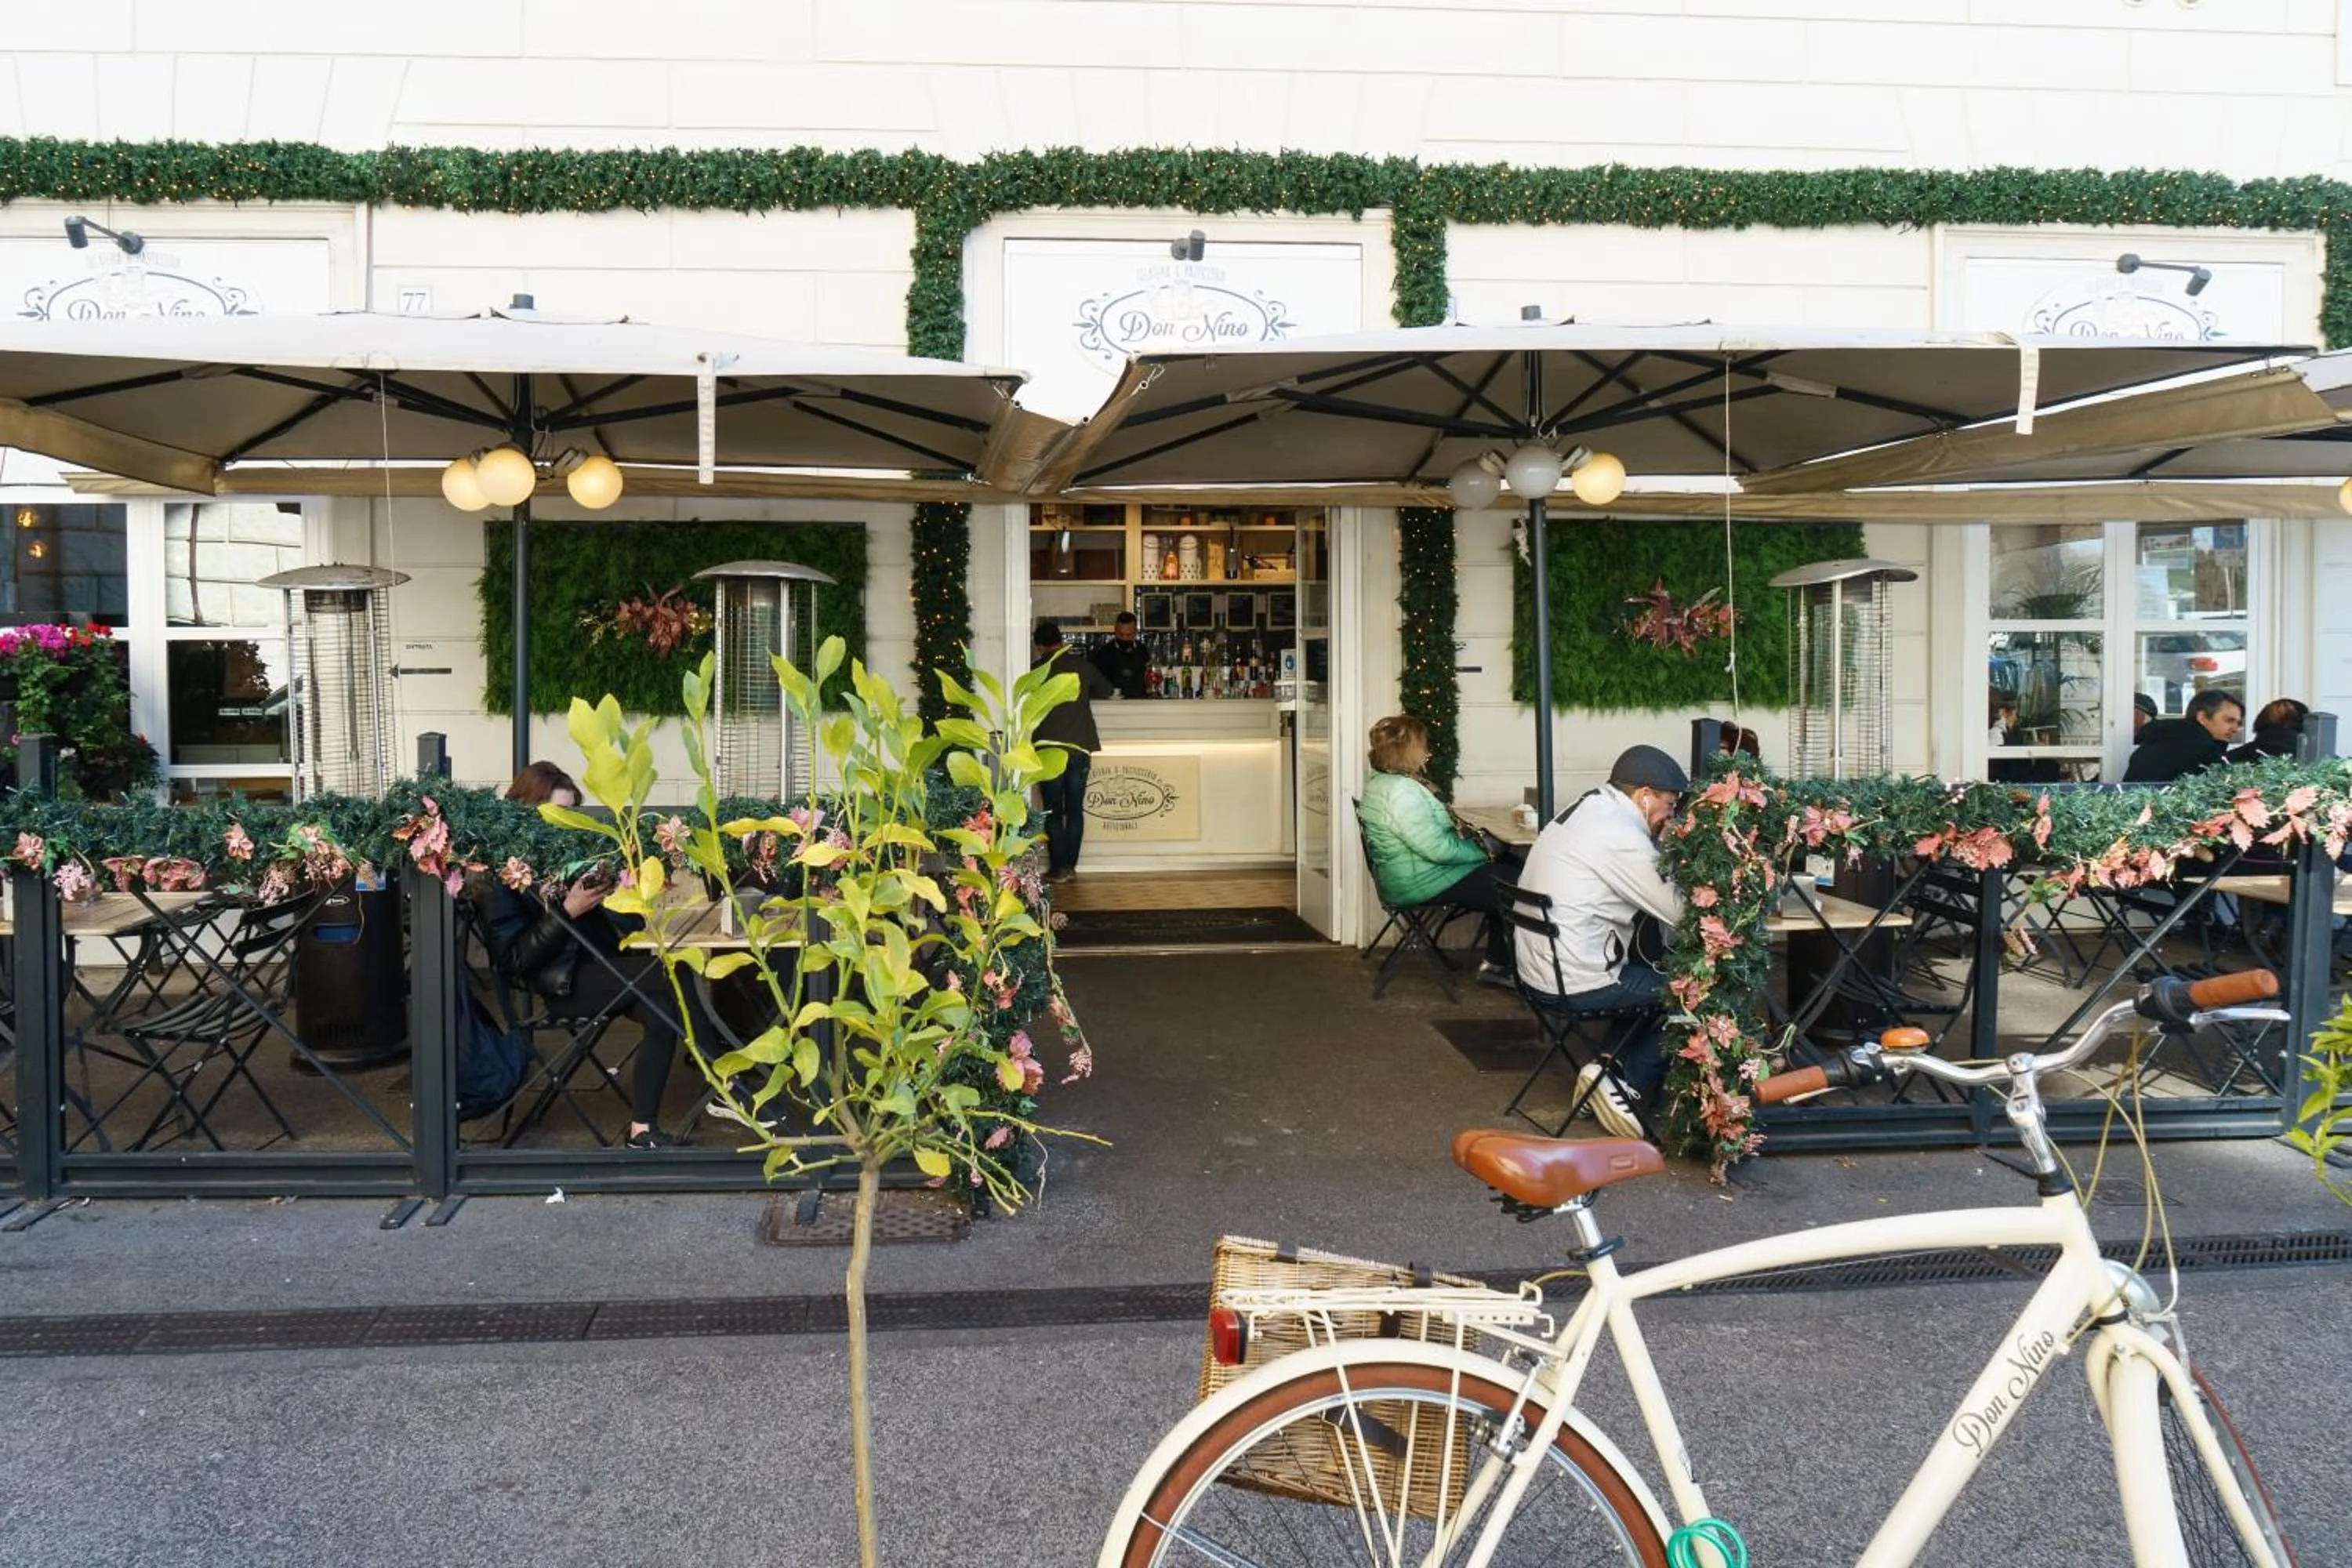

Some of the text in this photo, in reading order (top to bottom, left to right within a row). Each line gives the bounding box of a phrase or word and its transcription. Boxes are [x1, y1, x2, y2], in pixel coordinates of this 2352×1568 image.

[402, 292, 426, 313] 77
[1120, 310, 1247, 342] Don Nino
[1087, 791, 1155, 808] Don Nino
[1953, 1330, 2055, 1458] Don Nino
